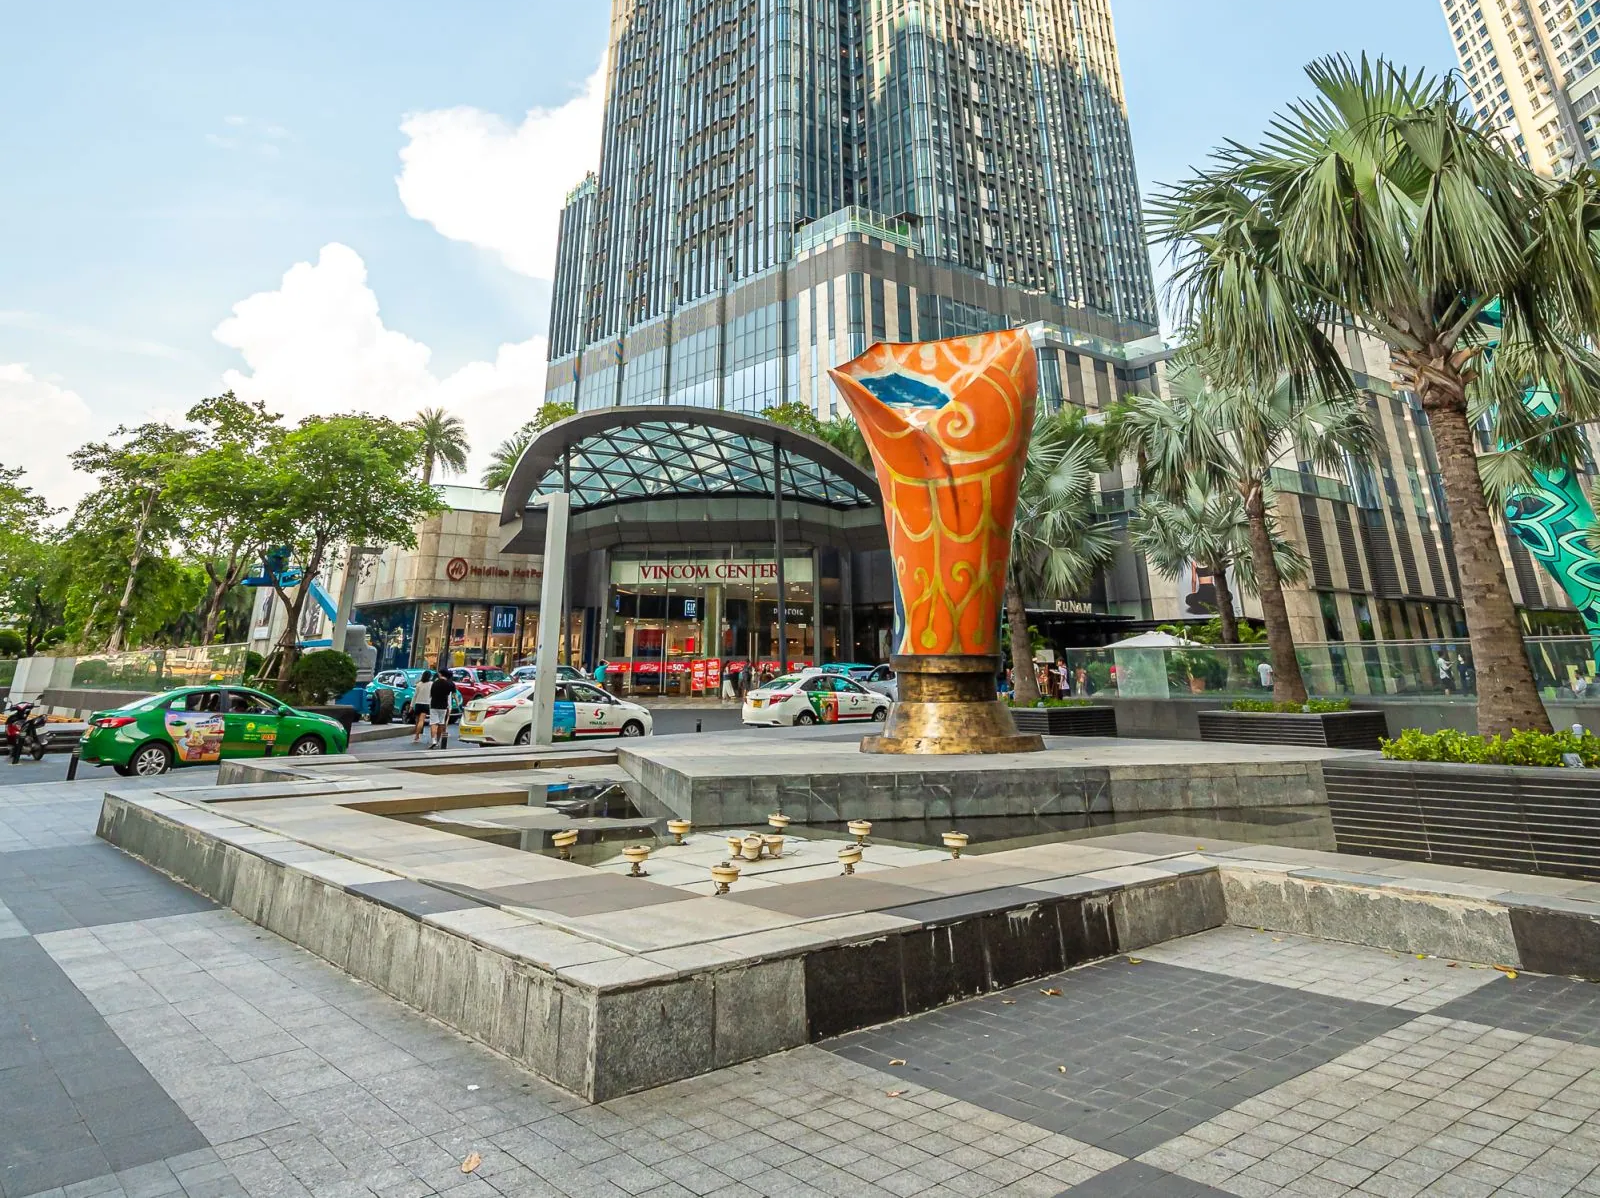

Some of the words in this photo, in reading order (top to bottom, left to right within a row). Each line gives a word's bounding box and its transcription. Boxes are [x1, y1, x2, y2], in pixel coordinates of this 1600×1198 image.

[640, 565, 710, 579] VINCOM
[715, 563, 778, 578] CENTER
[496, 613, 514, 628] GAP
